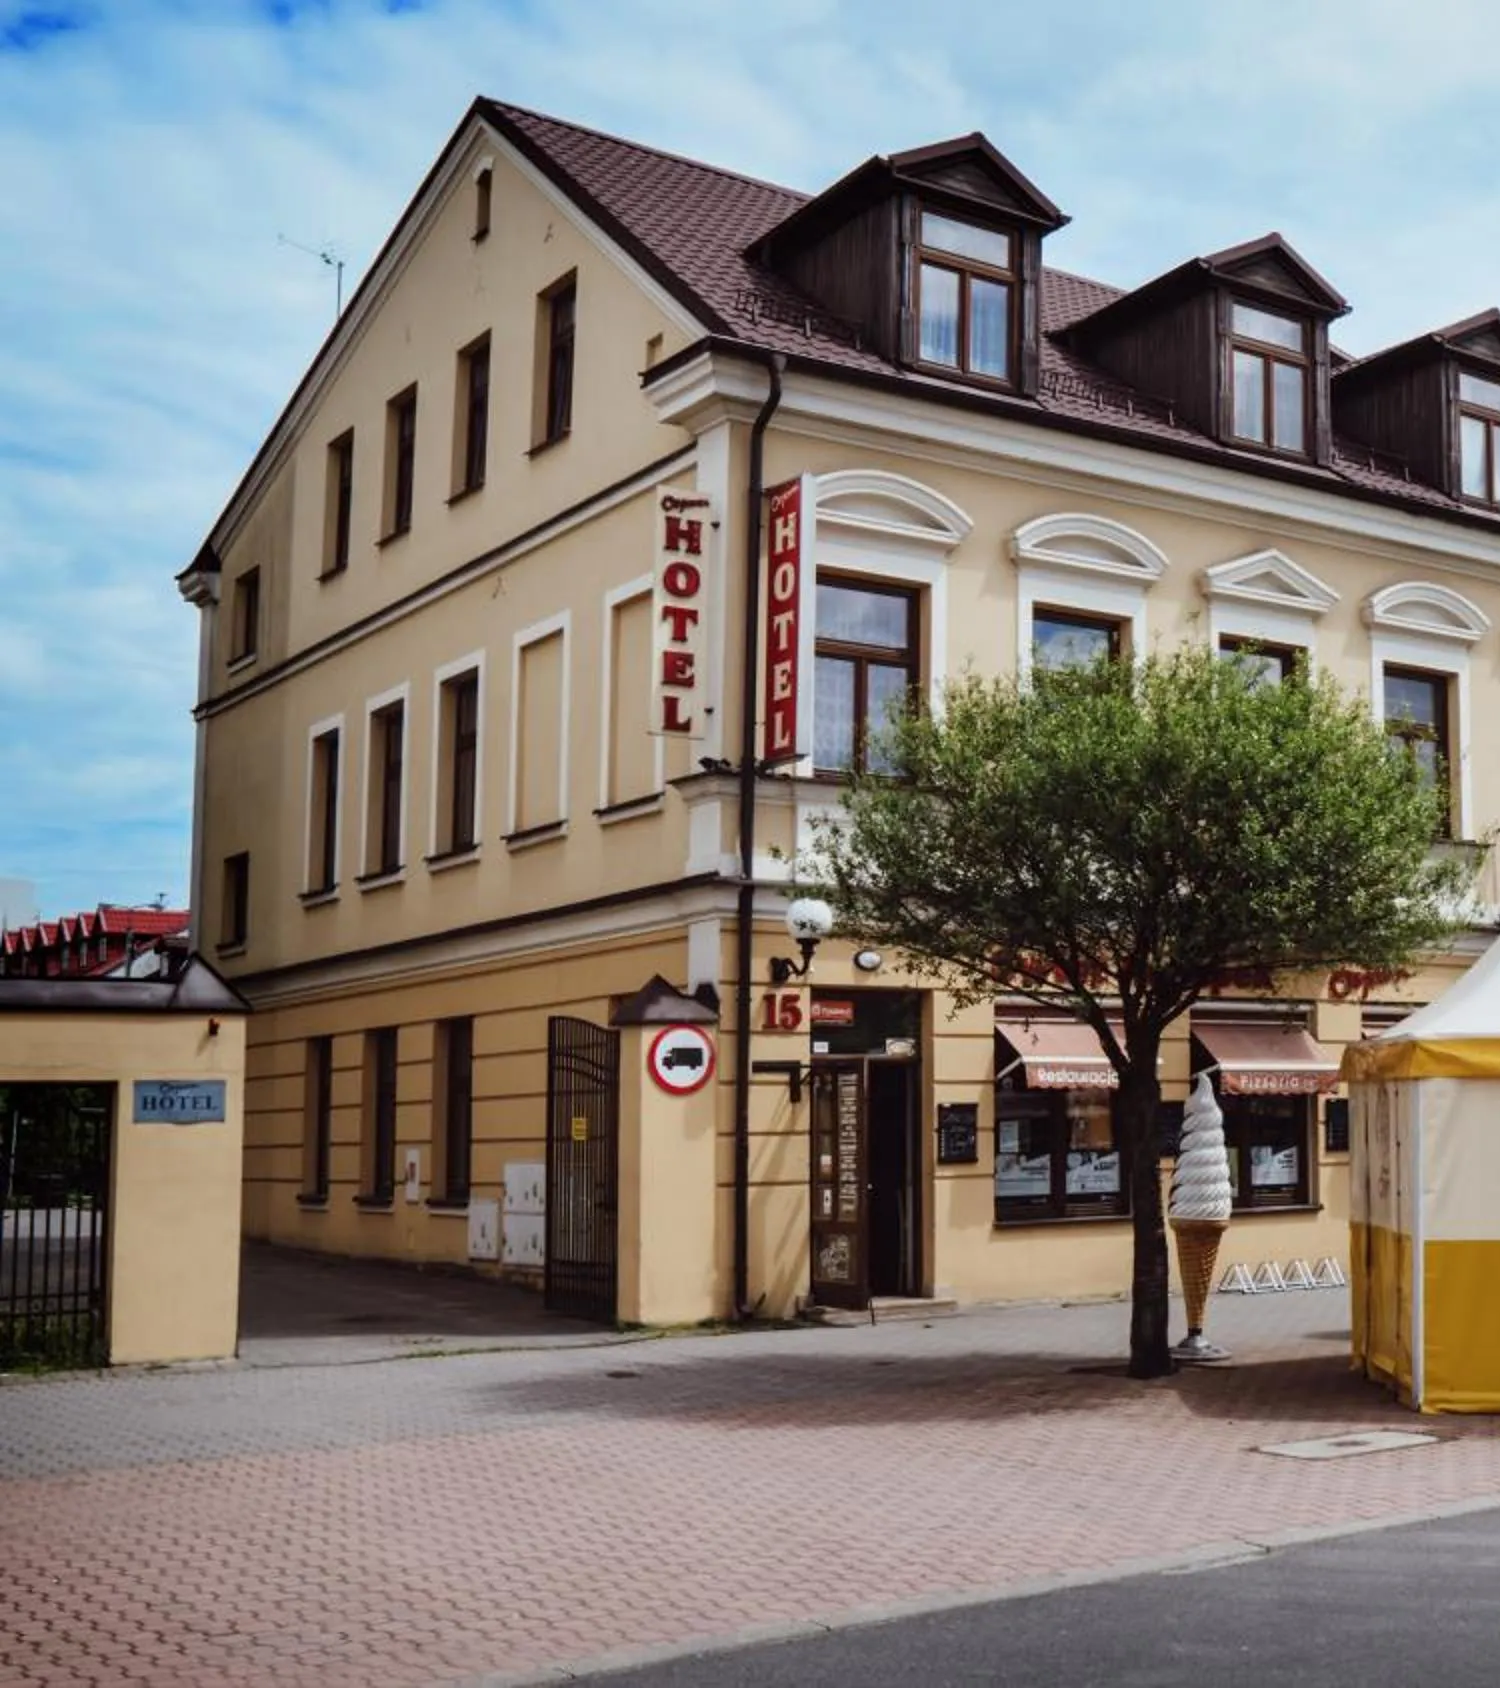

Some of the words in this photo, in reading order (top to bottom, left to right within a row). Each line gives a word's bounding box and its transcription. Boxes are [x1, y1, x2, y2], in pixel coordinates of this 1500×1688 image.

[661, 516, 701, 733] HOTEL
[772, 511, 796, 749] HOTEL
[761, 993, 803, 1031] 15
[142, 1095, 219, 1111] HOTEL
